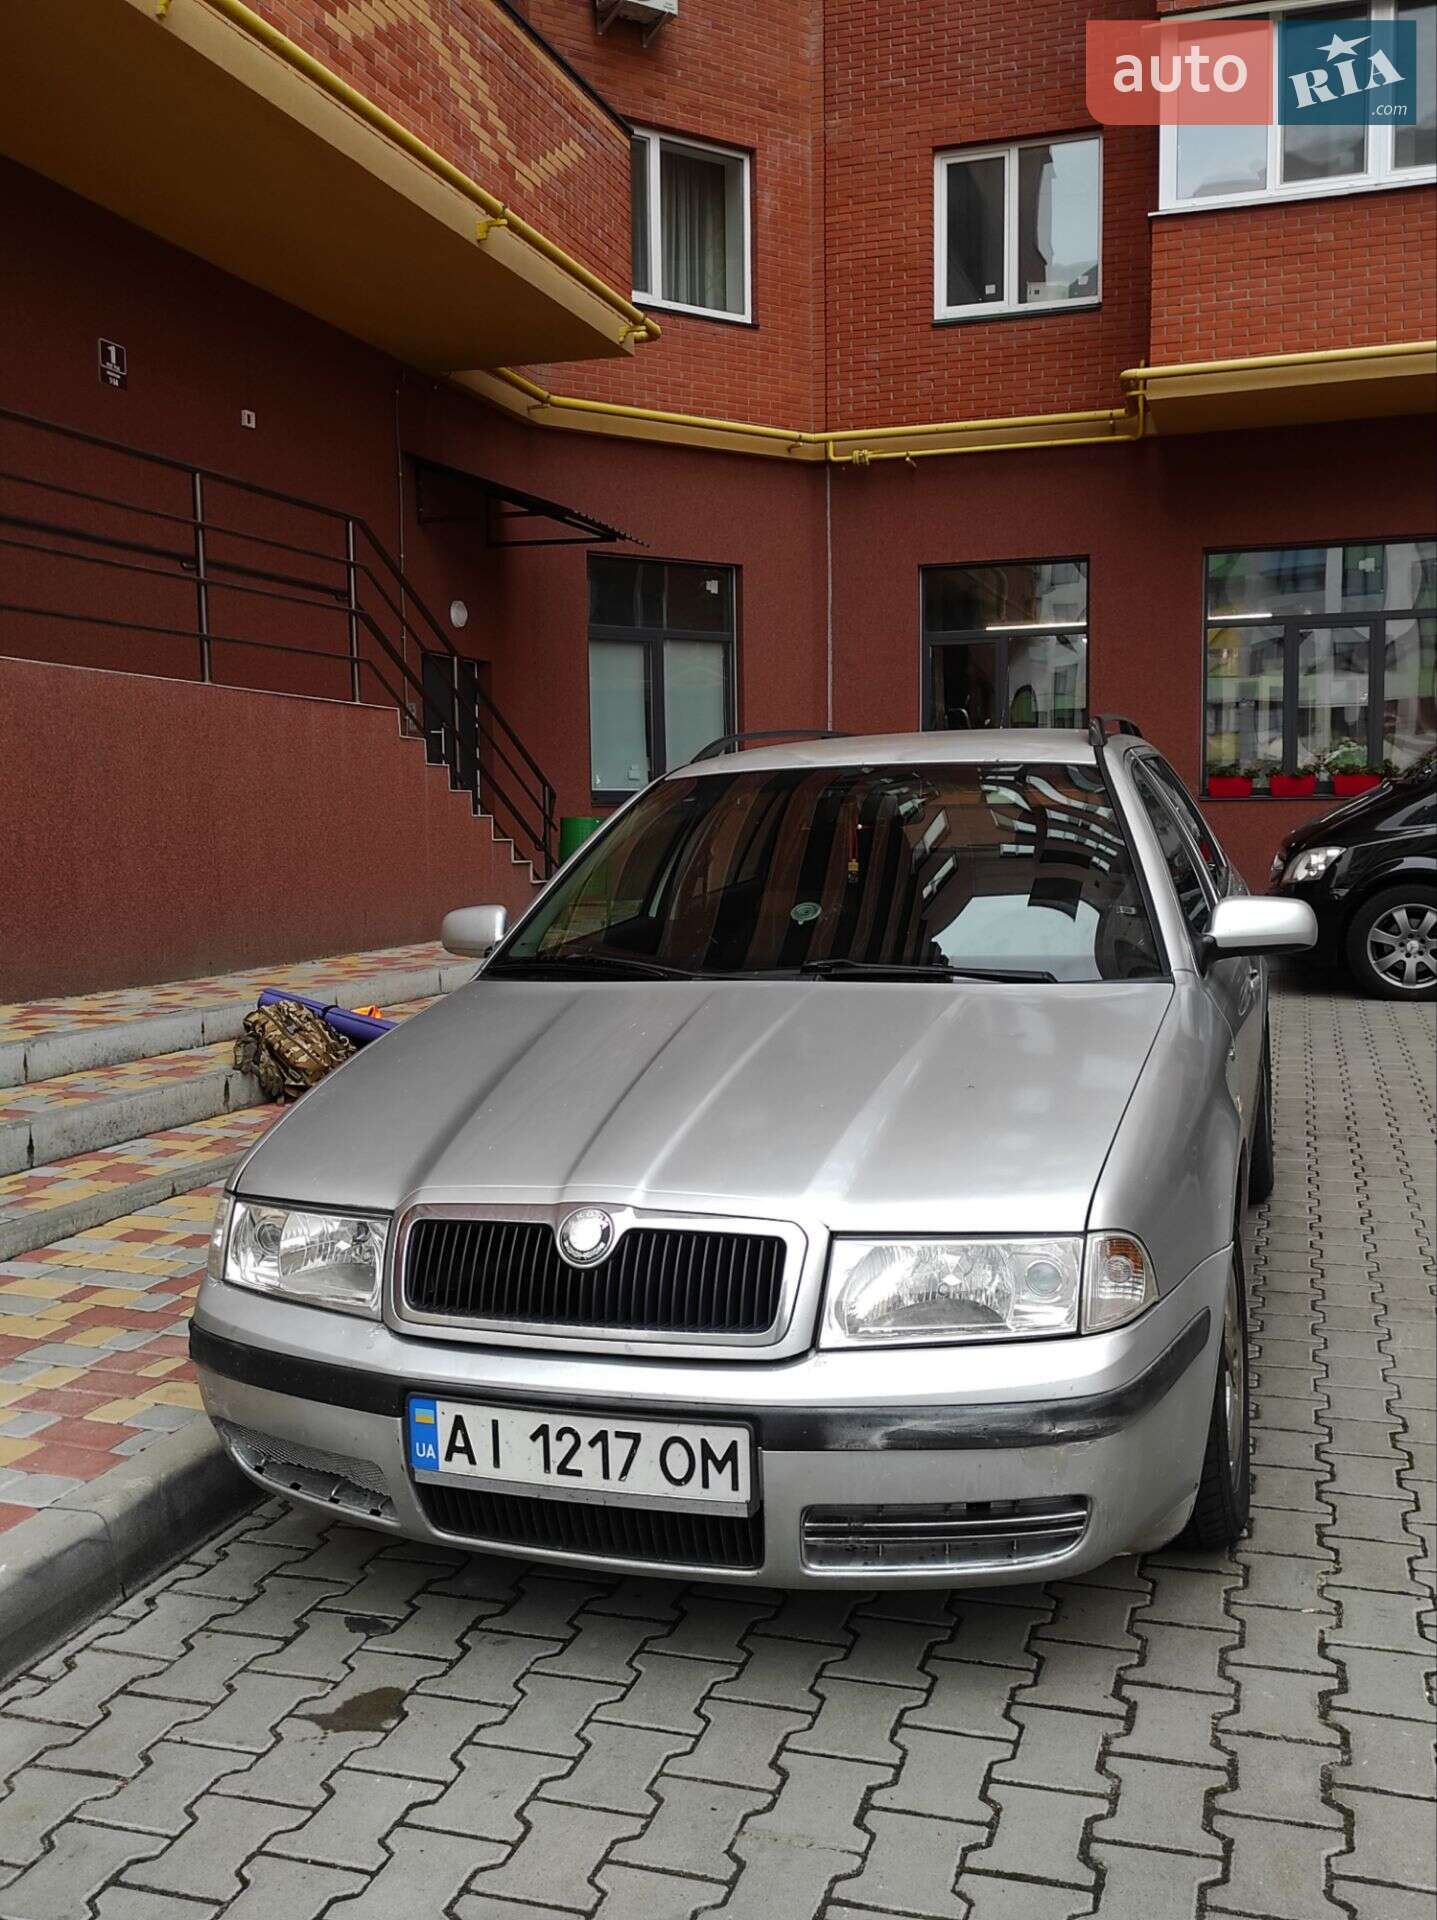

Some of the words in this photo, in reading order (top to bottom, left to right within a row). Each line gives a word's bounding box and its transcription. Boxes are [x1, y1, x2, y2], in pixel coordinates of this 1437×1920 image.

[107, 345, 116, 364] 1
[415, 1442, 436, 1459] UA
[529, 1423, 642, 1481] 1217
[659, 1435, 739, 1491] OM
